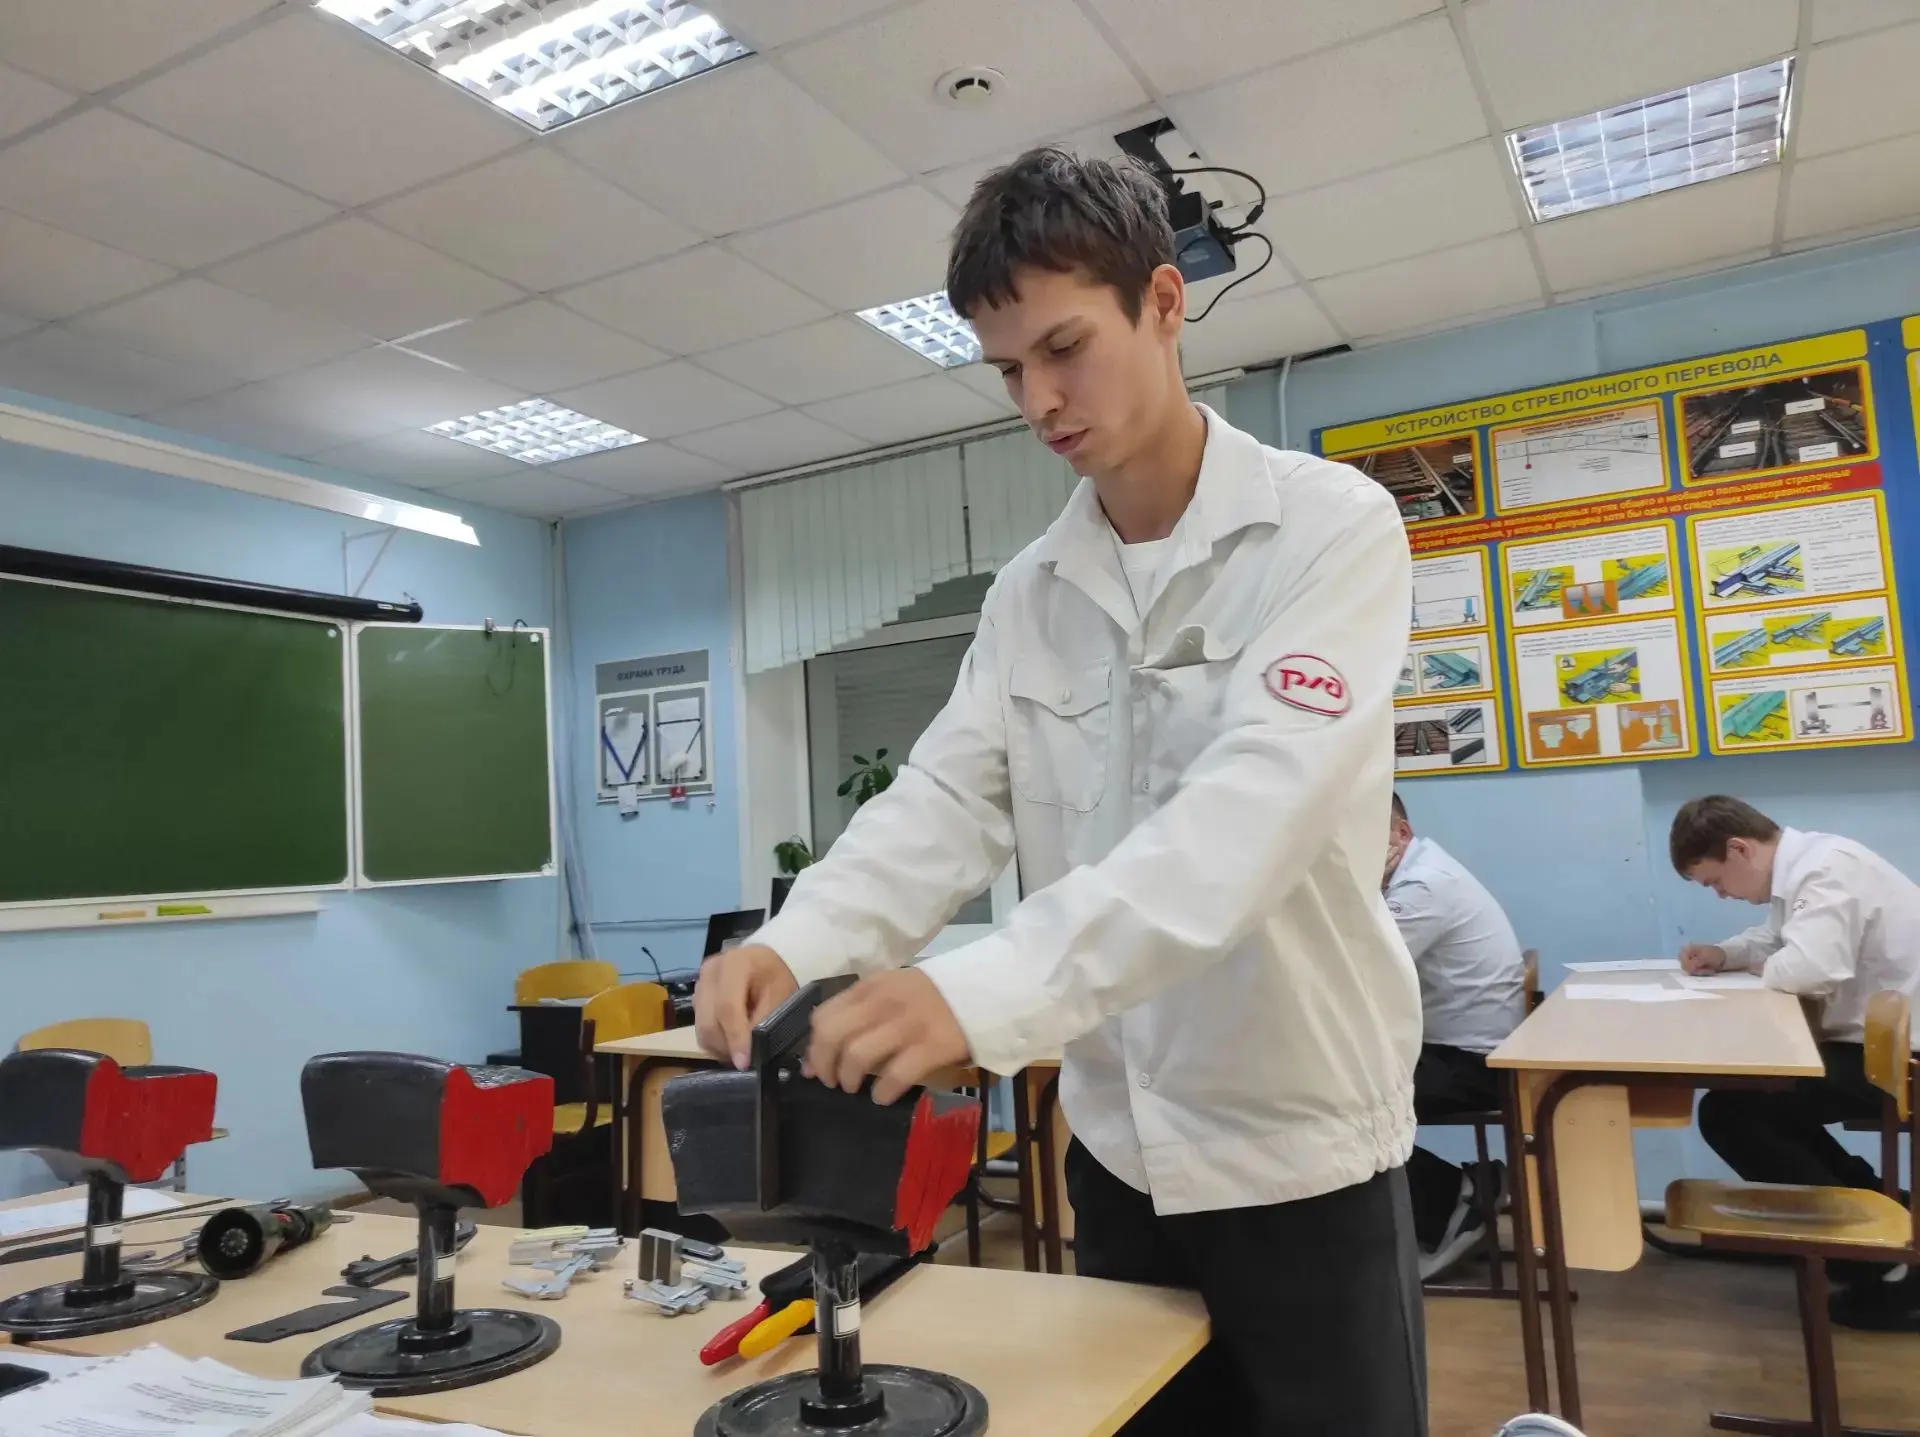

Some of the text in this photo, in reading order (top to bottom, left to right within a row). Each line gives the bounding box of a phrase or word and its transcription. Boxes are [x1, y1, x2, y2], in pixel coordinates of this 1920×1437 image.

[1384, 402, 1507, 437] УСТРОЙСТВО
[1511, 375, 1659, 412] СТРЕЛОЧНОГО
[1666, 351, 1783, 384] ПЕРЕВОДА
[617, 665, 685, 681] ОХРАНА ТРУДА
